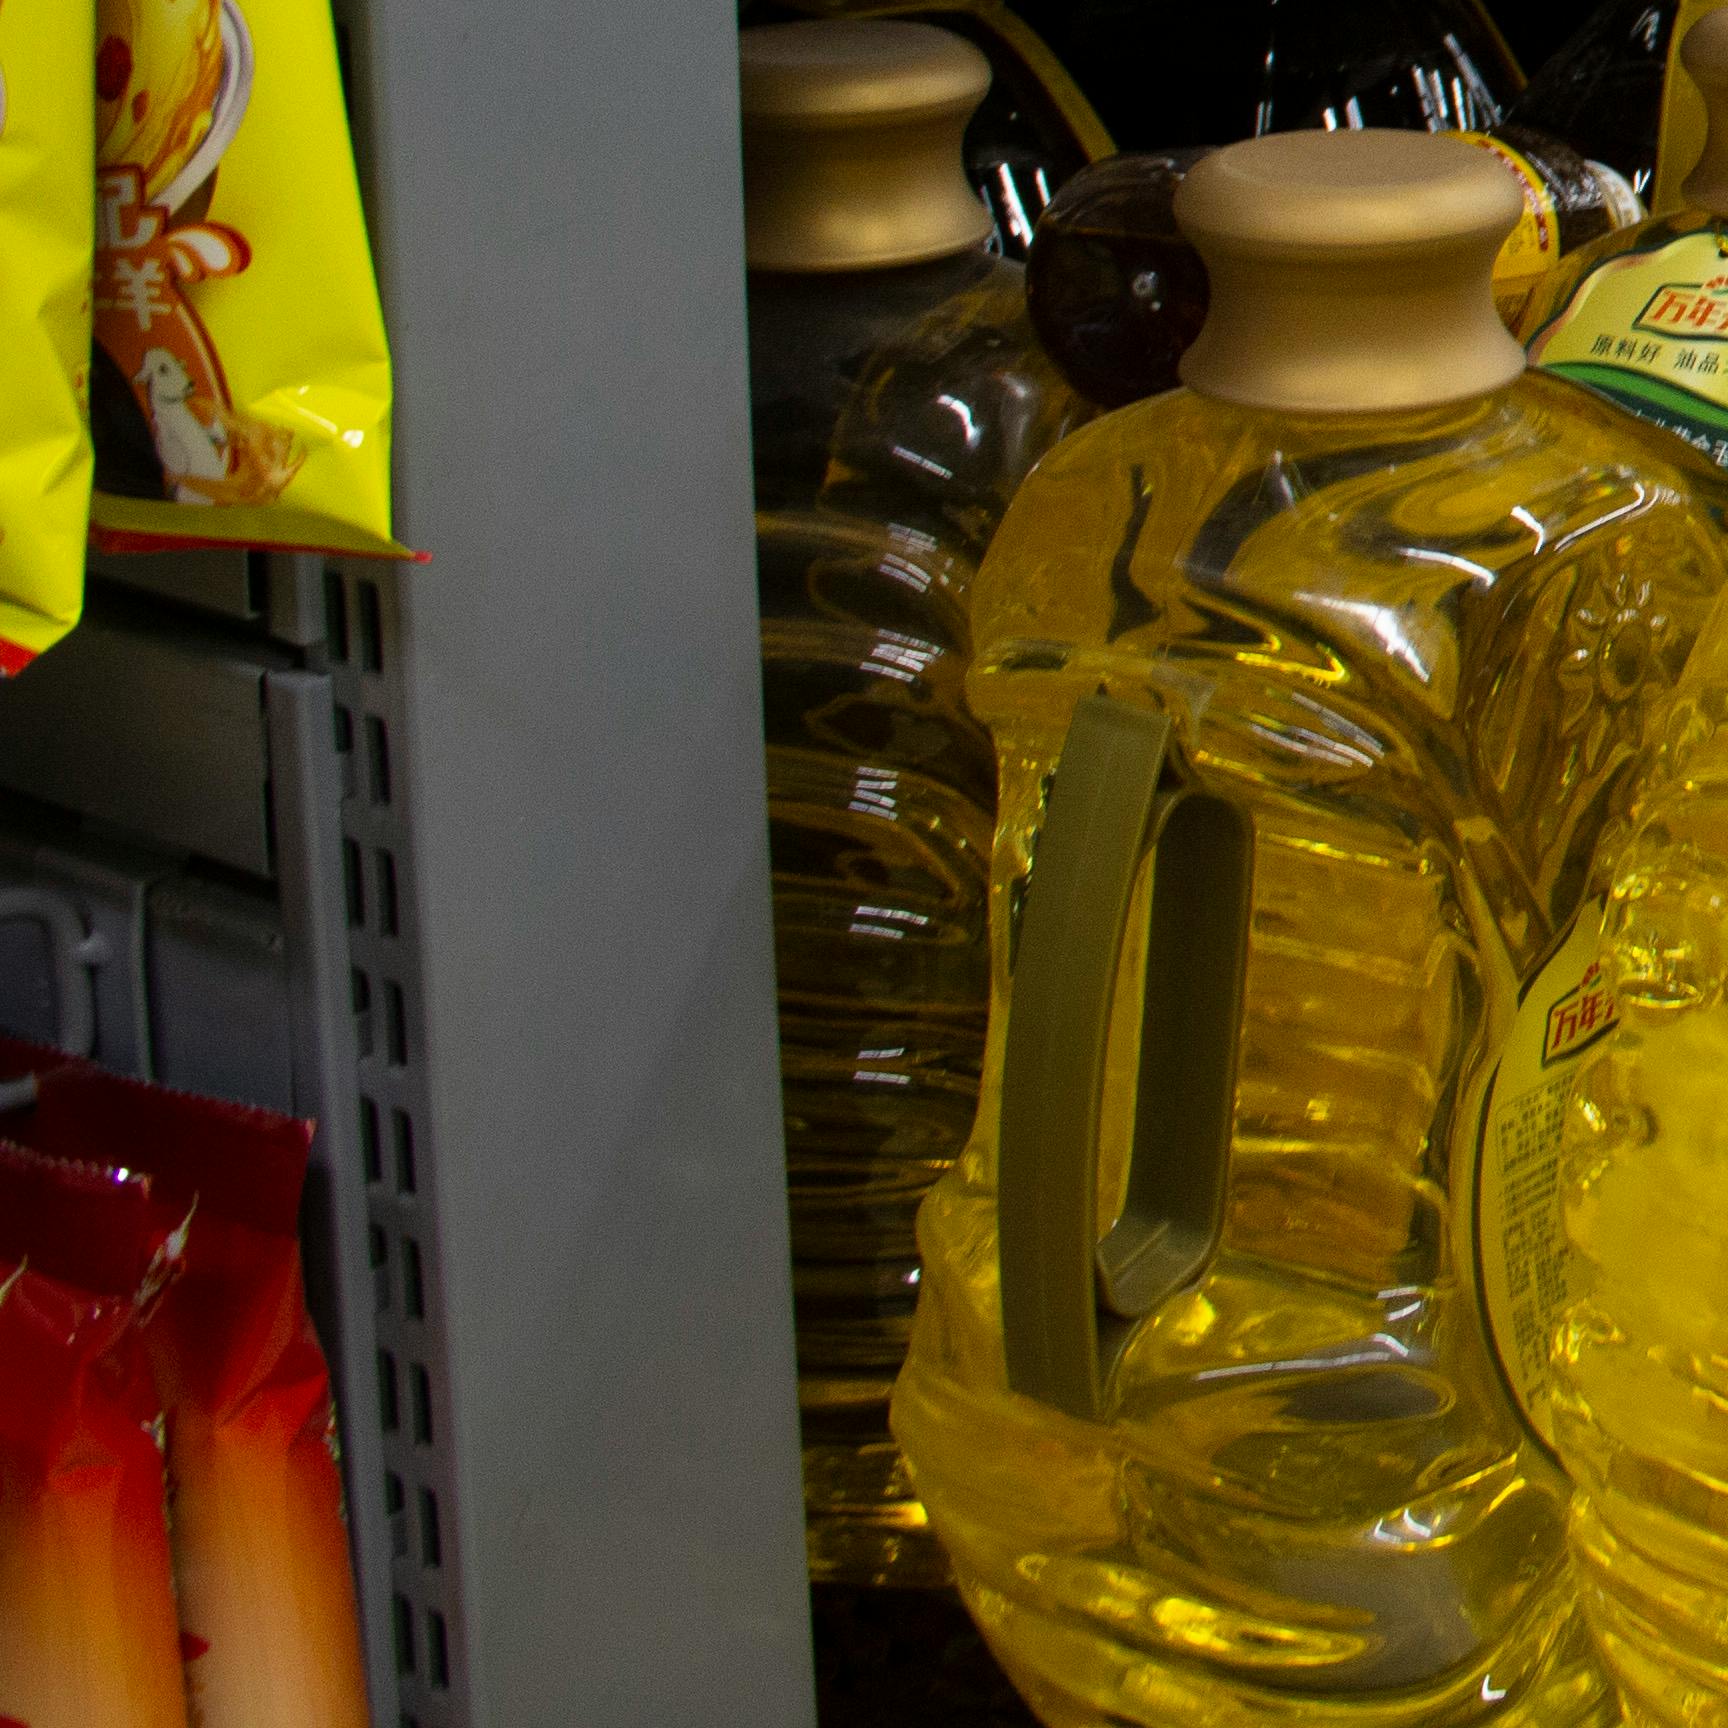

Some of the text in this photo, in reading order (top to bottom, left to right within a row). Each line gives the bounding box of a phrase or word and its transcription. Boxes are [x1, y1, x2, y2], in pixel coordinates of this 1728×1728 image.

[1590, 334, 1663, 364] 原料好
[1551, 987, 1614, 1051] 万年
